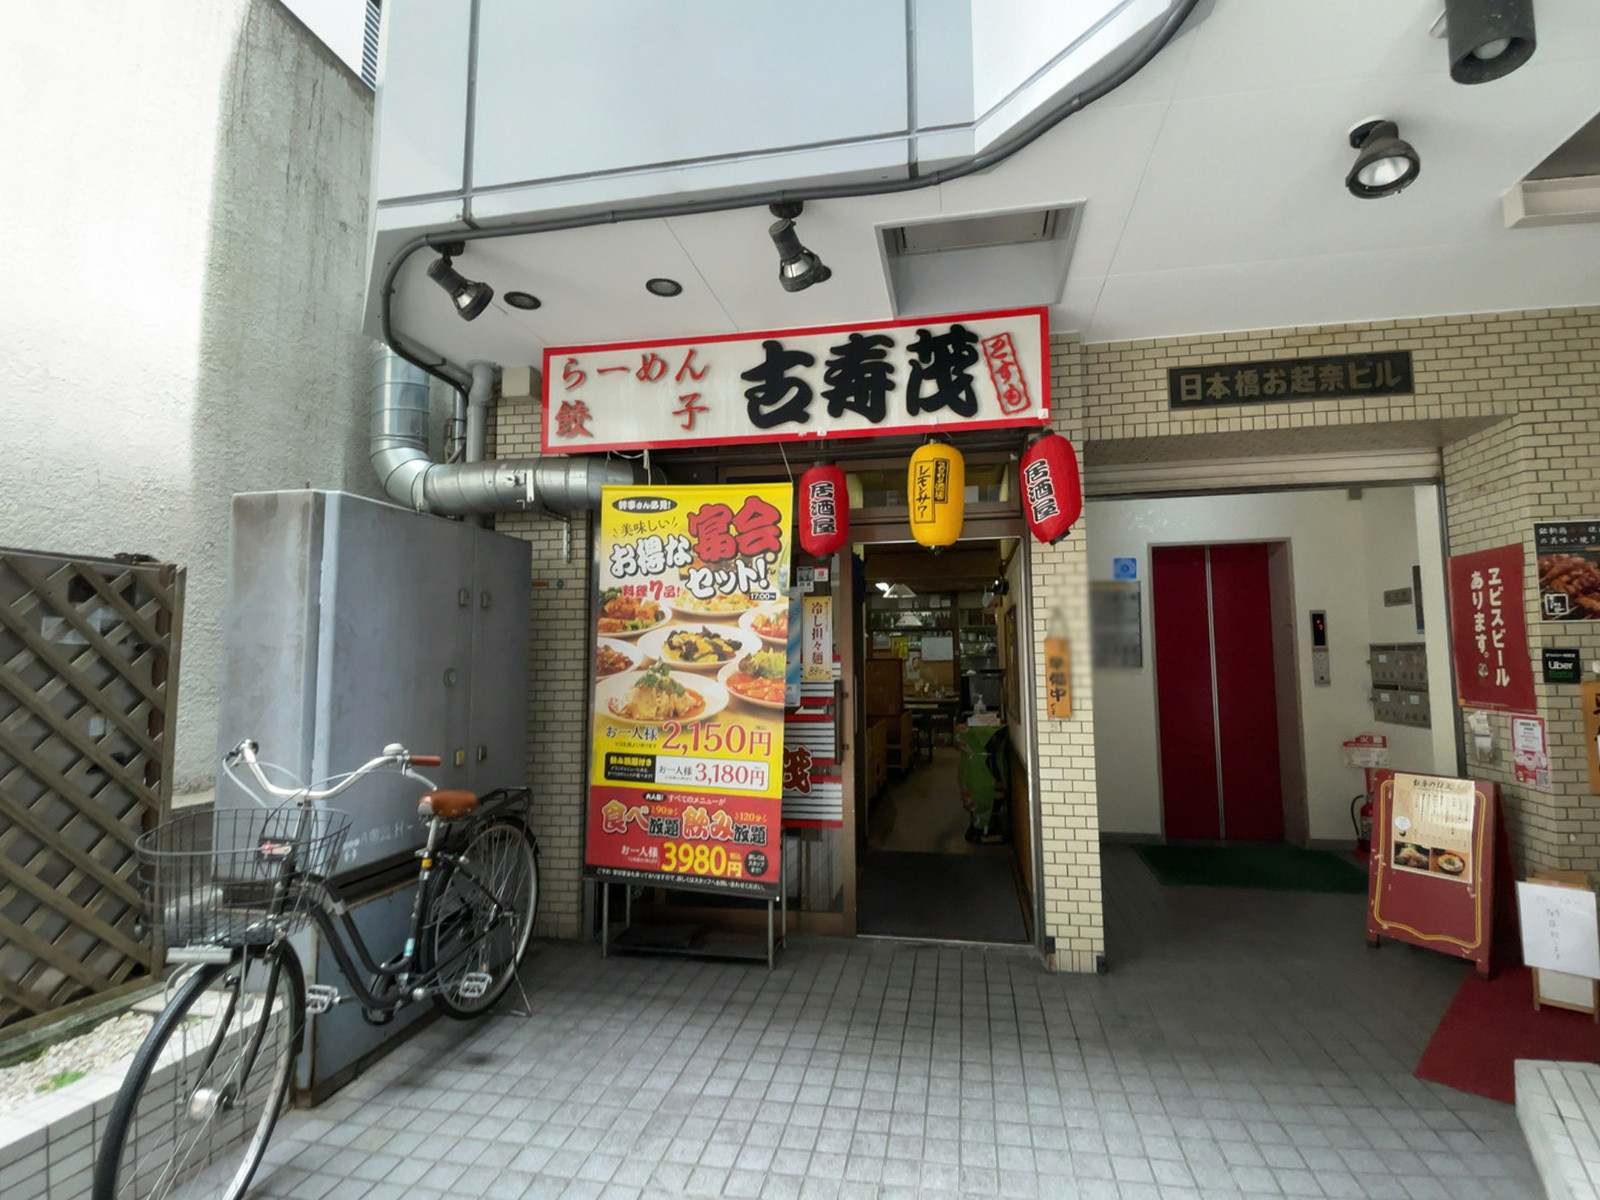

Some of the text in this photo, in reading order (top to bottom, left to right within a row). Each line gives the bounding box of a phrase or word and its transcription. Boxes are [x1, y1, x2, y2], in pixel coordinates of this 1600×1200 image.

[561, 348, 710, 391] らーめん
[741, 324, 980, 428] 古寿茂
[809, 481, 837, 536] 居酒屋
[1023, 459, 1058, 524] 居酒屋
[621, 518, 672, 538] 美味しい
[610, 534, 692, 578] お得な
[622, 579, 681, 600] 料理7品!
[685, 557, 770, 600] セット!
[1470, 571, 1489, 658] あります。
[1548, 660, 1573, 670] Uber
[605, 721, 772, 757] お一人様 2,150円
[659, 763, 765, 786] お一人様 3,180円
[621, 842, 743, 878] お一人様 3980円
